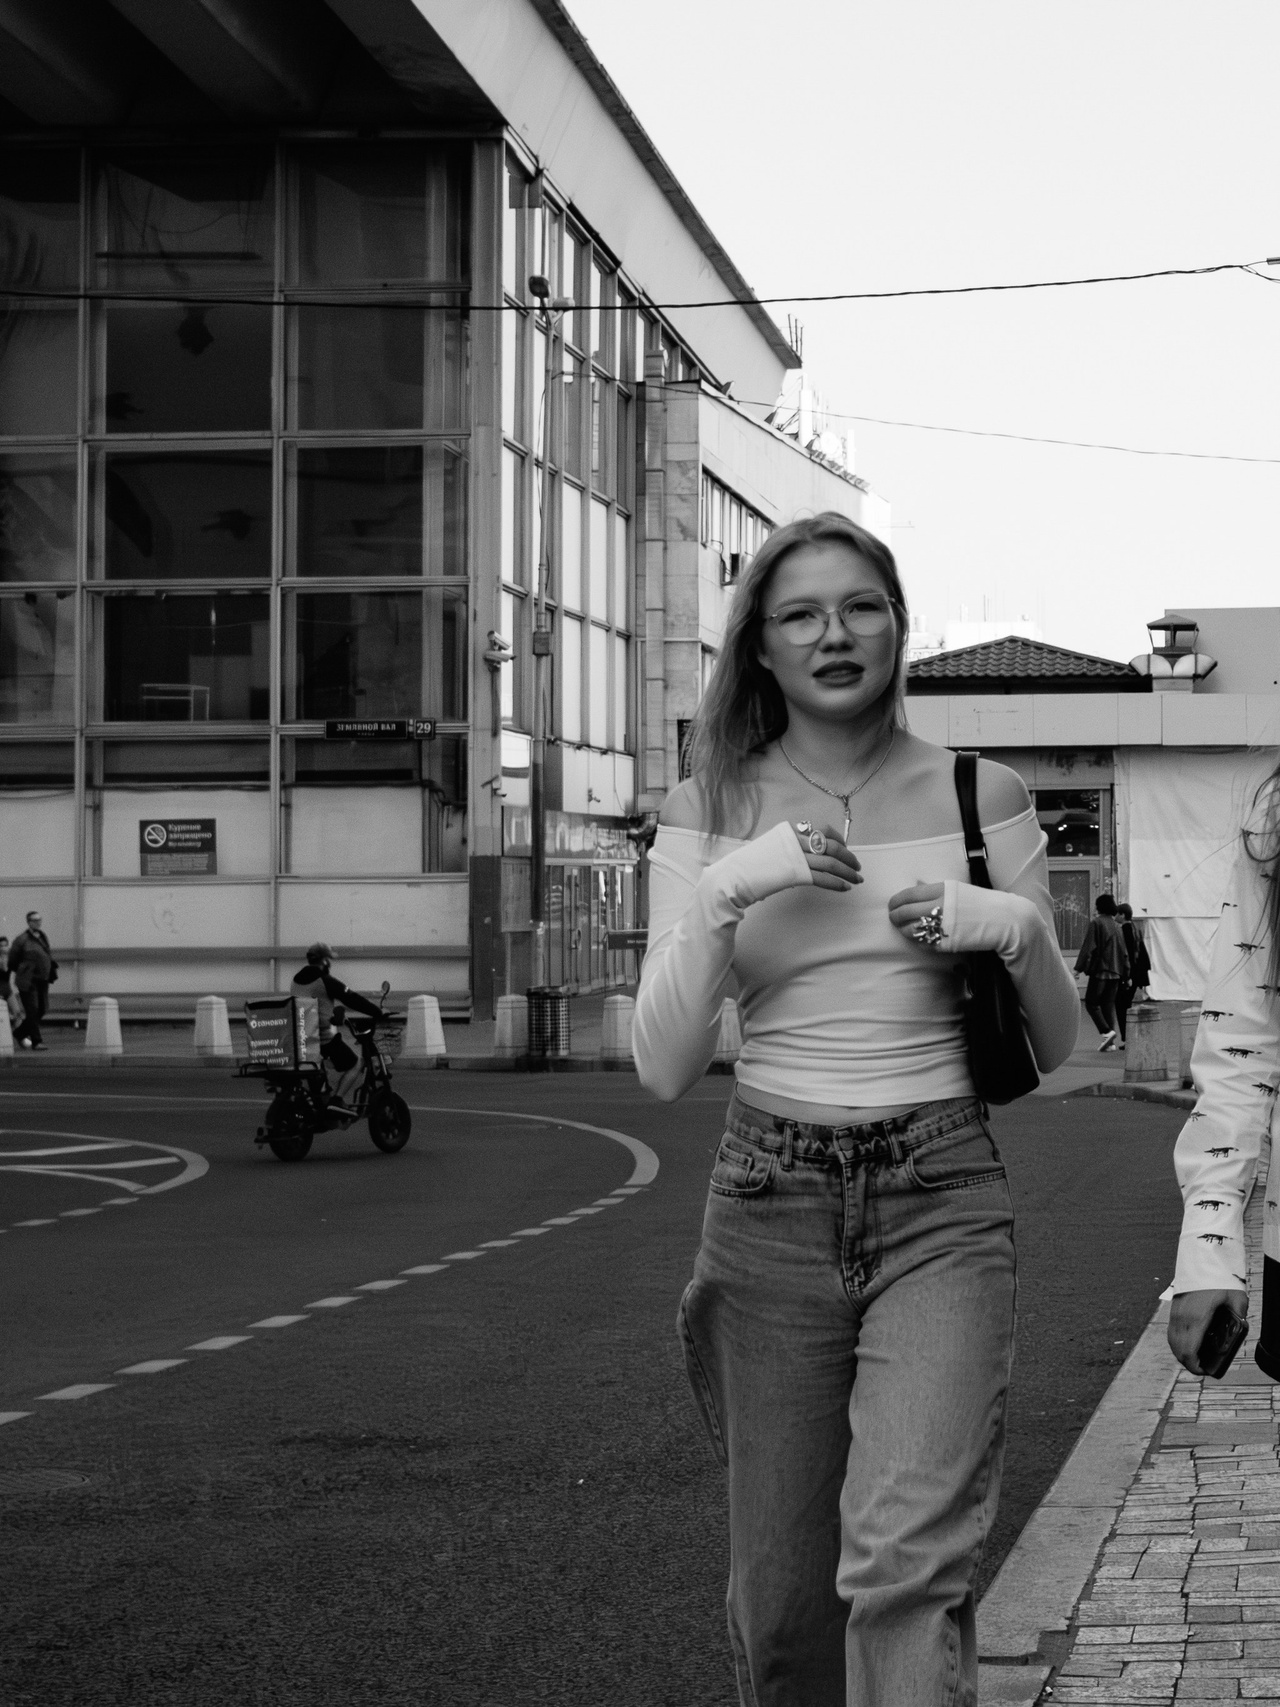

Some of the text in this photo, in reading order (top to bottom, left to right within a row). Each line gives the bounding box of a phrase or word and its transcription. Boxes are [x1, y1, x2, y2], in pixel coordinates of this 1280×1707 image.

[336, 723, 396, 731] ЗЕМЛЯНОЙ ВАЛ
[416, 722, 432, 734] 29
[168, 824, 201, 832] Курение
[168, 832, 212, 841] запрещено
